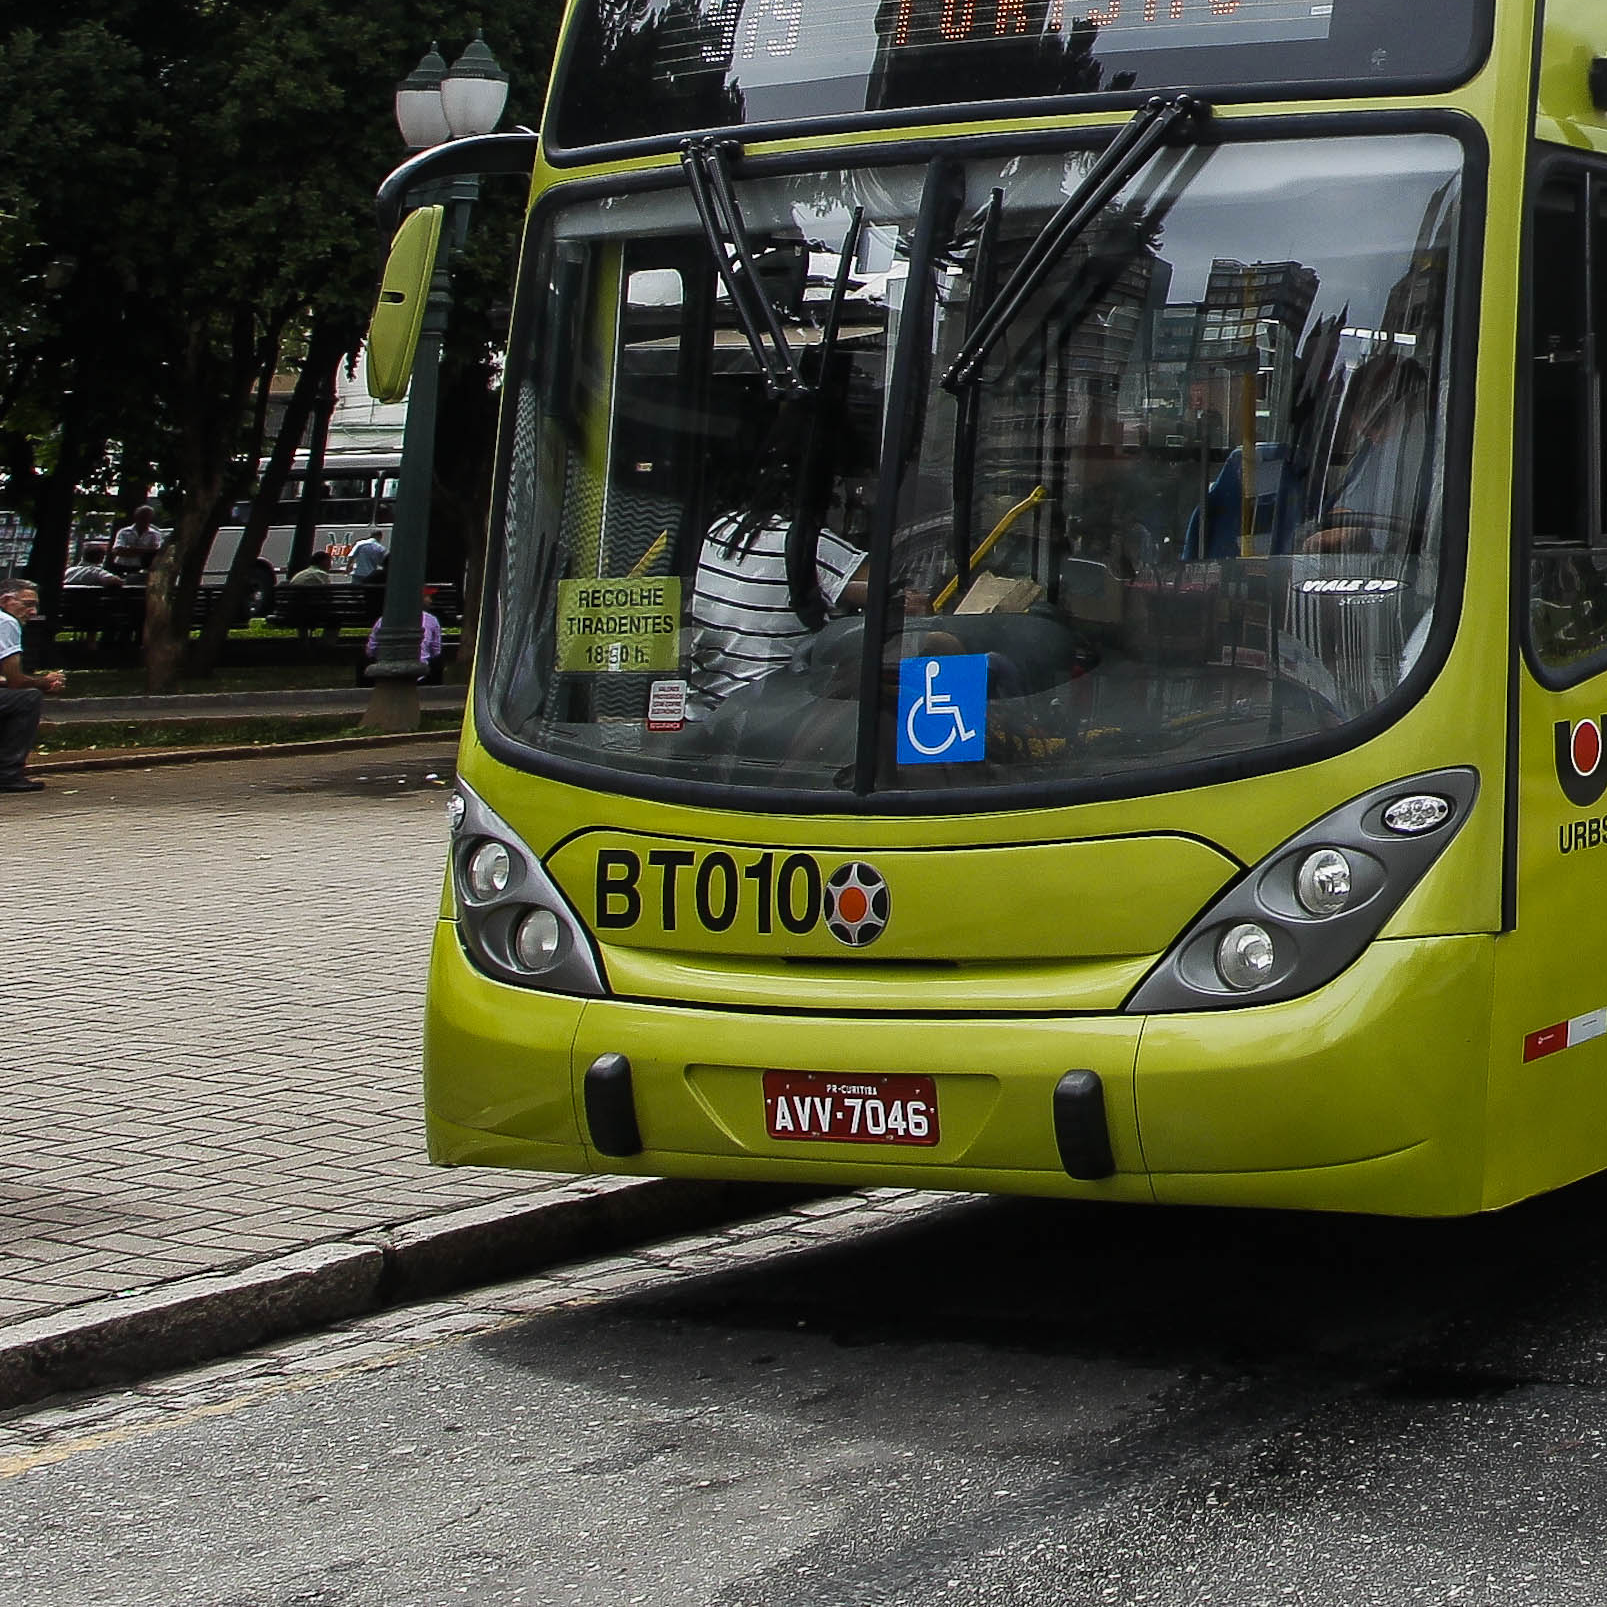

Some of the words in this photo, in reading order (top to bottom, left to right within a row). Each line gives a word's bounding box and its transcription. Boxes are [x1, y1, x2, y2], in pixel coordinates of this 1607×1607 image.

[1302, 579, 1364, 593] VIALE
[578, 587, 664, 609] RECOLHE
[567, 615, 674, 635] TIRADENTES
[596, 849, 822, 935] BT010
[774, 1095, 930, 1137] AVV-7046
